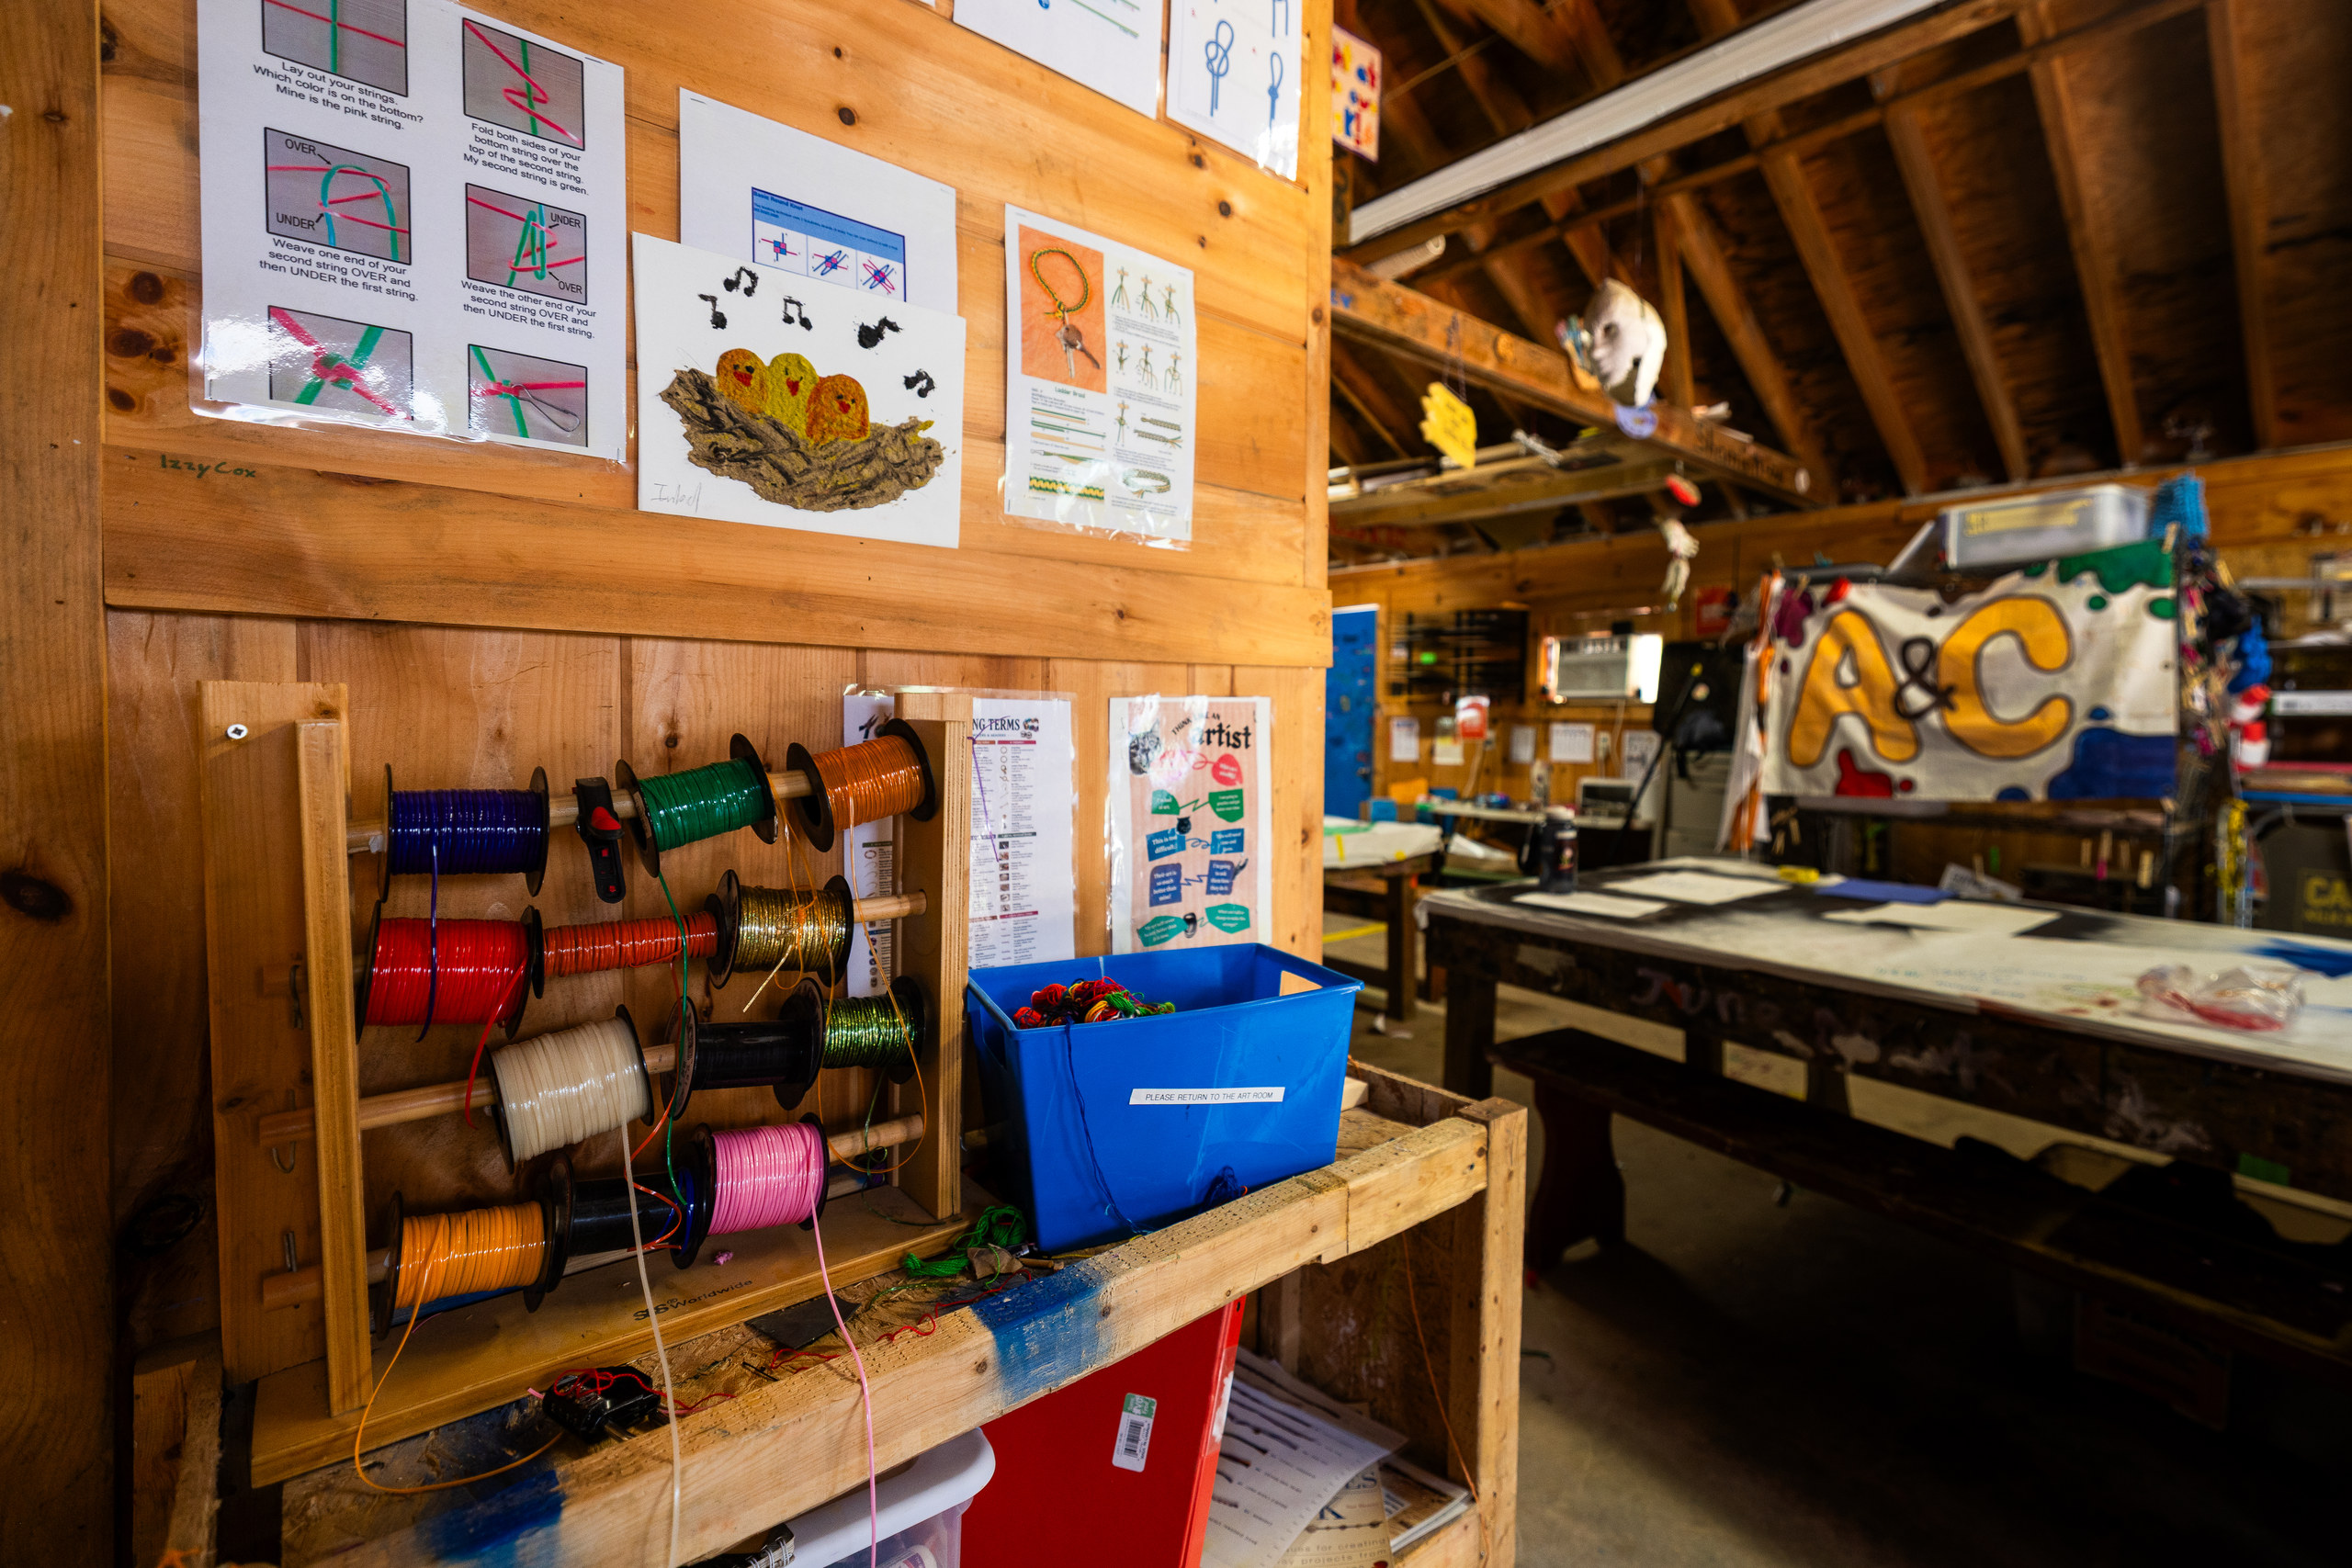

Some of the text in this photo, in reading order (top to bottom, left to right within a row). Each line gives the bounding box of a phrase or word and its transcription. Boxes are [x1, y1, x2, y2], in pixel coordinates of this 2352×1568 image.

[253, 64, 424, 124] Which color is on the bottom?
[281, 62, 398, 105] Lay out your strings.
[276, 84, 404, 130] Mine is the pink string.
[285, 138, 317, 156] OVER
[471, 122, 582, 162] Fold both sides of your
[474, 134, 579, 172] bottom string over the
[463, 152, 480, 165] My
[481, 160, 518, 175] second
[520, 171, 547, 186] string
[560, 183, 589, 196] green.
[469, 144, 583, 184] top of the second string.
[276, 212, 316, 231] UNDER
[549, 212, 582, 229] UNDER
[790, 202, 804, 211] Knot
[268, 251, 411, 288] second string OVER and
[272, 237, 407, 276] Weave one end of your
[259, 259, 419, 302] then UNDER the first string.
[558, 280, 582, 295] OVER
[460, 280, 596, 318] Weave the other end of your
[470, 294, 589, 327] second string OVER and
[463, 303, 595, 340] then UNDER the first string.
[161, 455, 256, 479] Izzy Cox
[1789, 595, 2074, 767] A&C
[988, 718, 1020, 731] TERMS
[1171, 717, 1193, 736] THINK
[1145, 1093, 1175, 1101] PLEASE
[1177, 1093, 1208, 1101] RETURN
[669, 1280, 752, 1309] Worldwide
[1301, 1554, 1353, 1565] projects
[1359, 1550, 1387, 1560] from
[1338, 1537, 1387, 1551] creating
